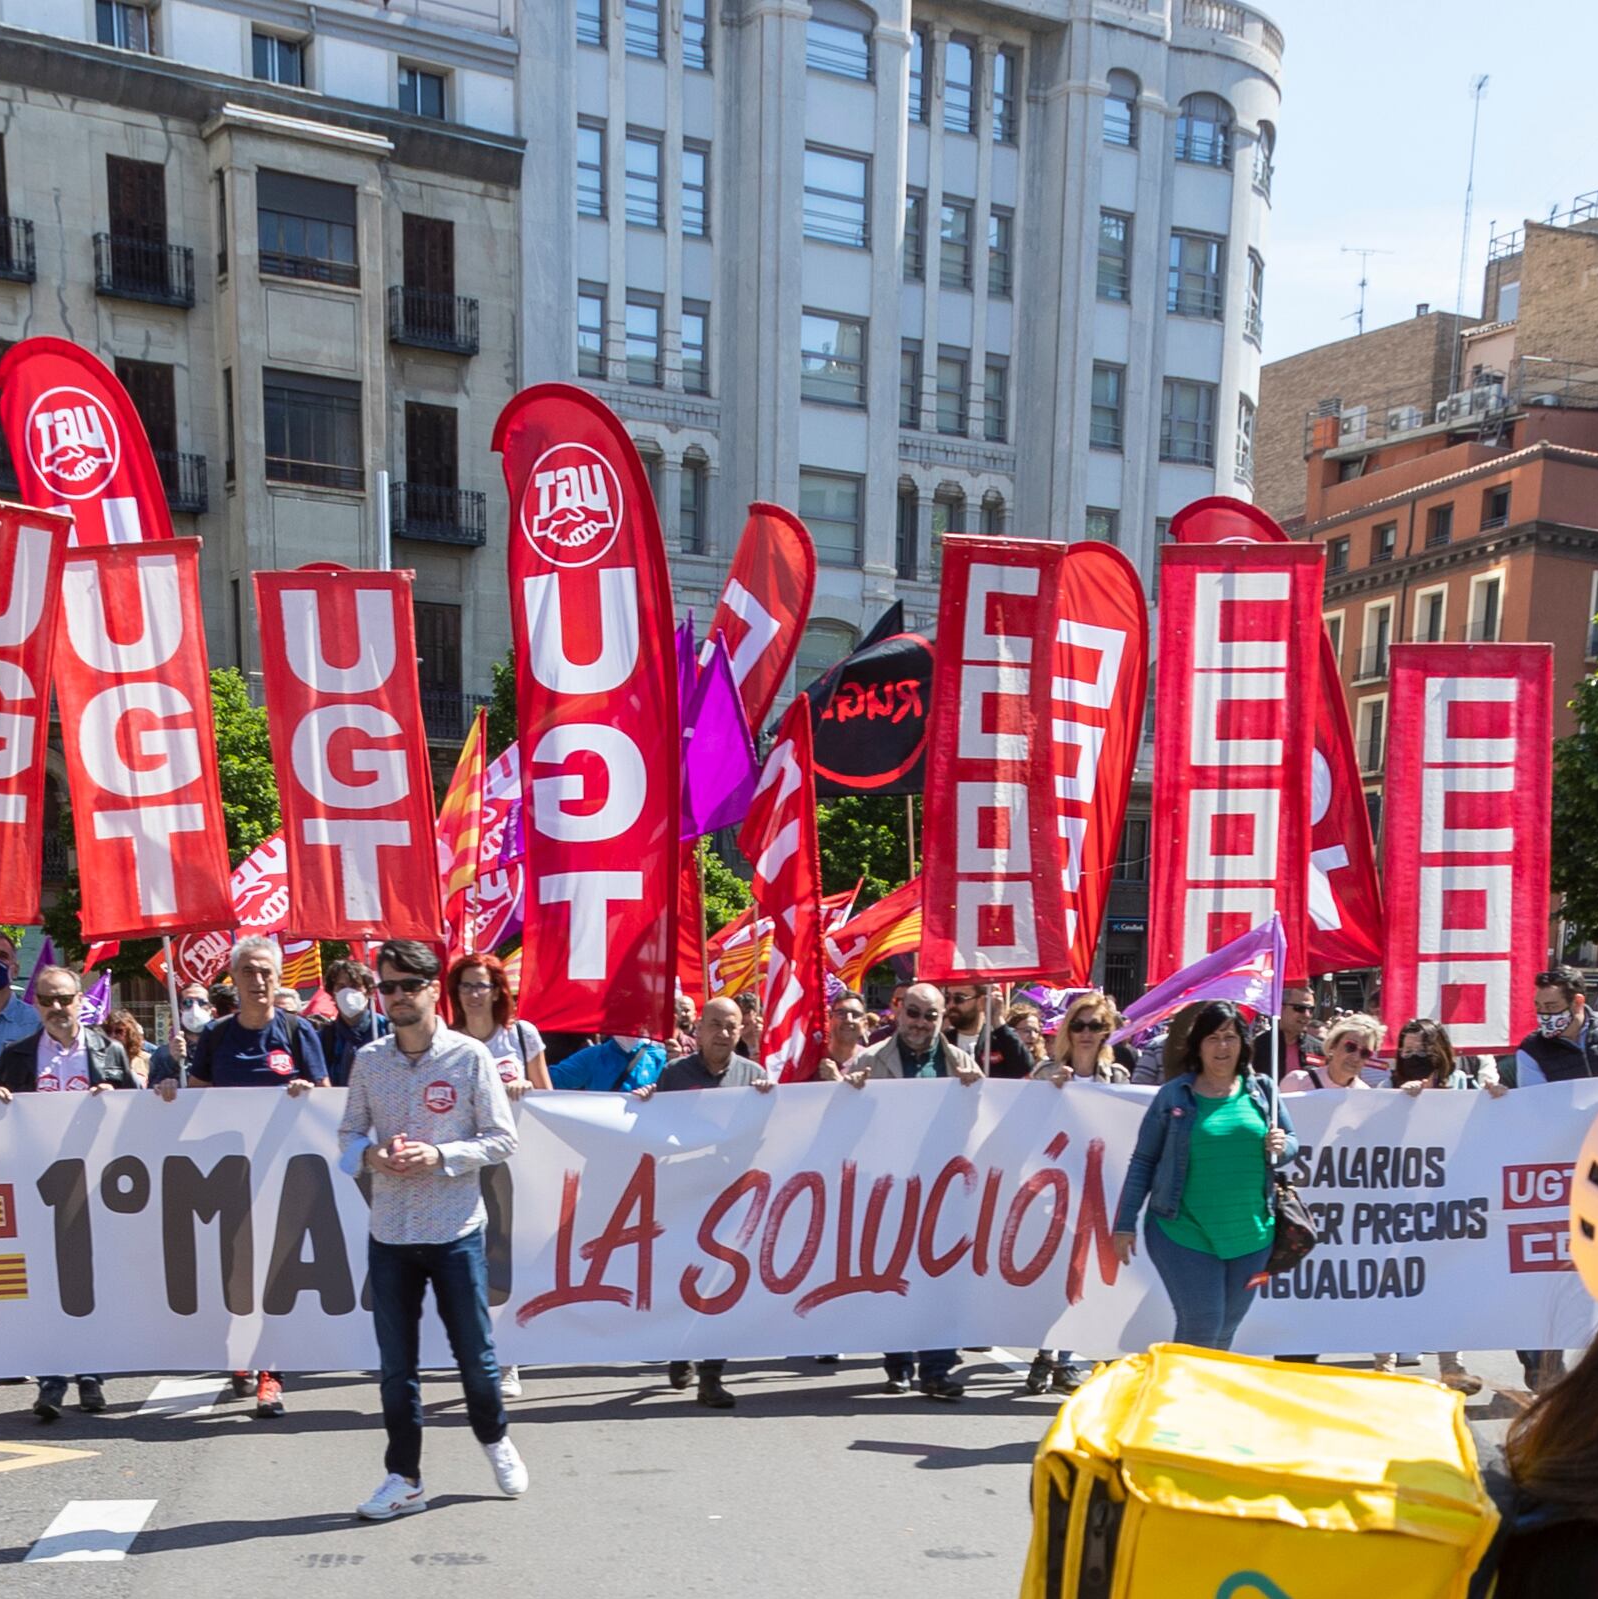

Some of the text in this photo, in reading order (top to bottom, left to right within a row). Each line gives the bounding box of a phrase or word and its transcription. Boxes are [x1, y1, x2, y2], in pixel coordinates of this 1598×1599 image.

[61, 554, 205, 917] UGT
[279, 588, 411, 922] UGT
[952, 563, 1041, 970] CCOO
[1182, 572, 1290, 968] CCOO
[1417, 677, 1518, 1047] CCOO
[515, 1131, 1124, 1328] LA SOLUCIÓN
[1291, 1145, 1446, 1188] SALARIOS
[1352, 1196, 1489, 1245] PRECIOS
